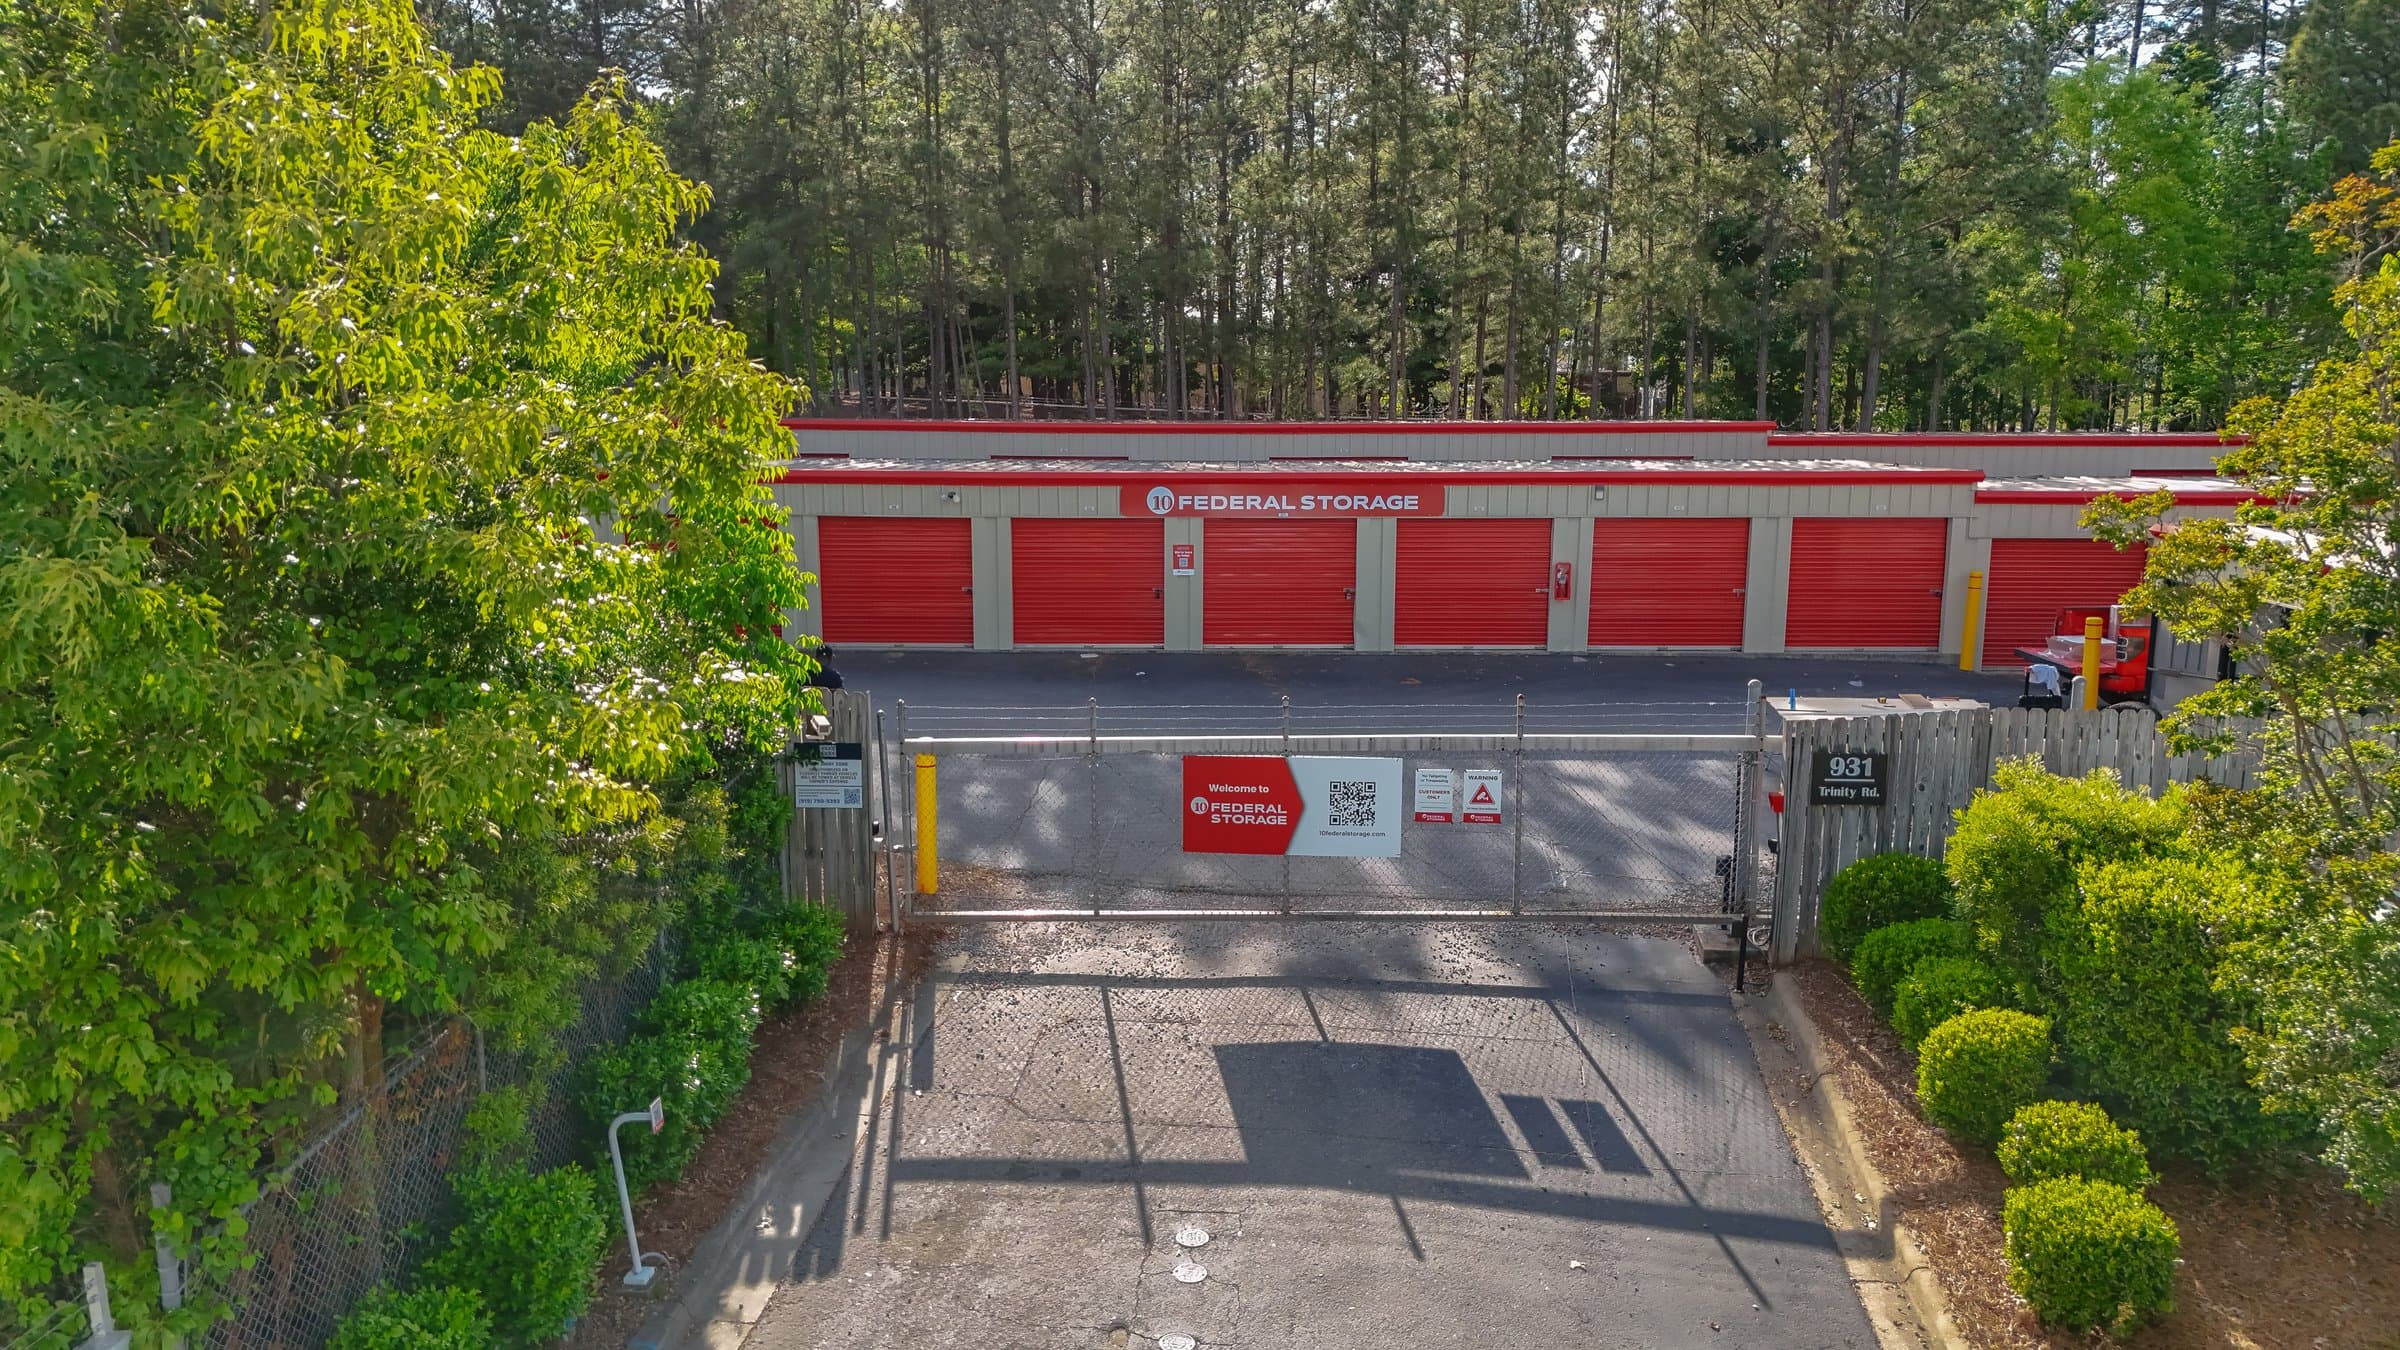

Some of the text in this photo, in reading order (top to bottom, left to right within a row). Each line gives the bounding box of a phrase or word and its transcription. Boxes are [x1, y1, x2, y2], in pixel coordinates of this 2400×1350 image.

[1152, 495, 1419, 511] 10 FEDERAL STORAGE
[1830, 757, 1873, 777] 931
[1209, 784, 1270, 793] Welcome to
[1819, 786, 1880, 799] Trinity Rd.
[1211, 803, 1288, 814] FEDERAL
[1211, 814, 1287, 825] STORAGE
